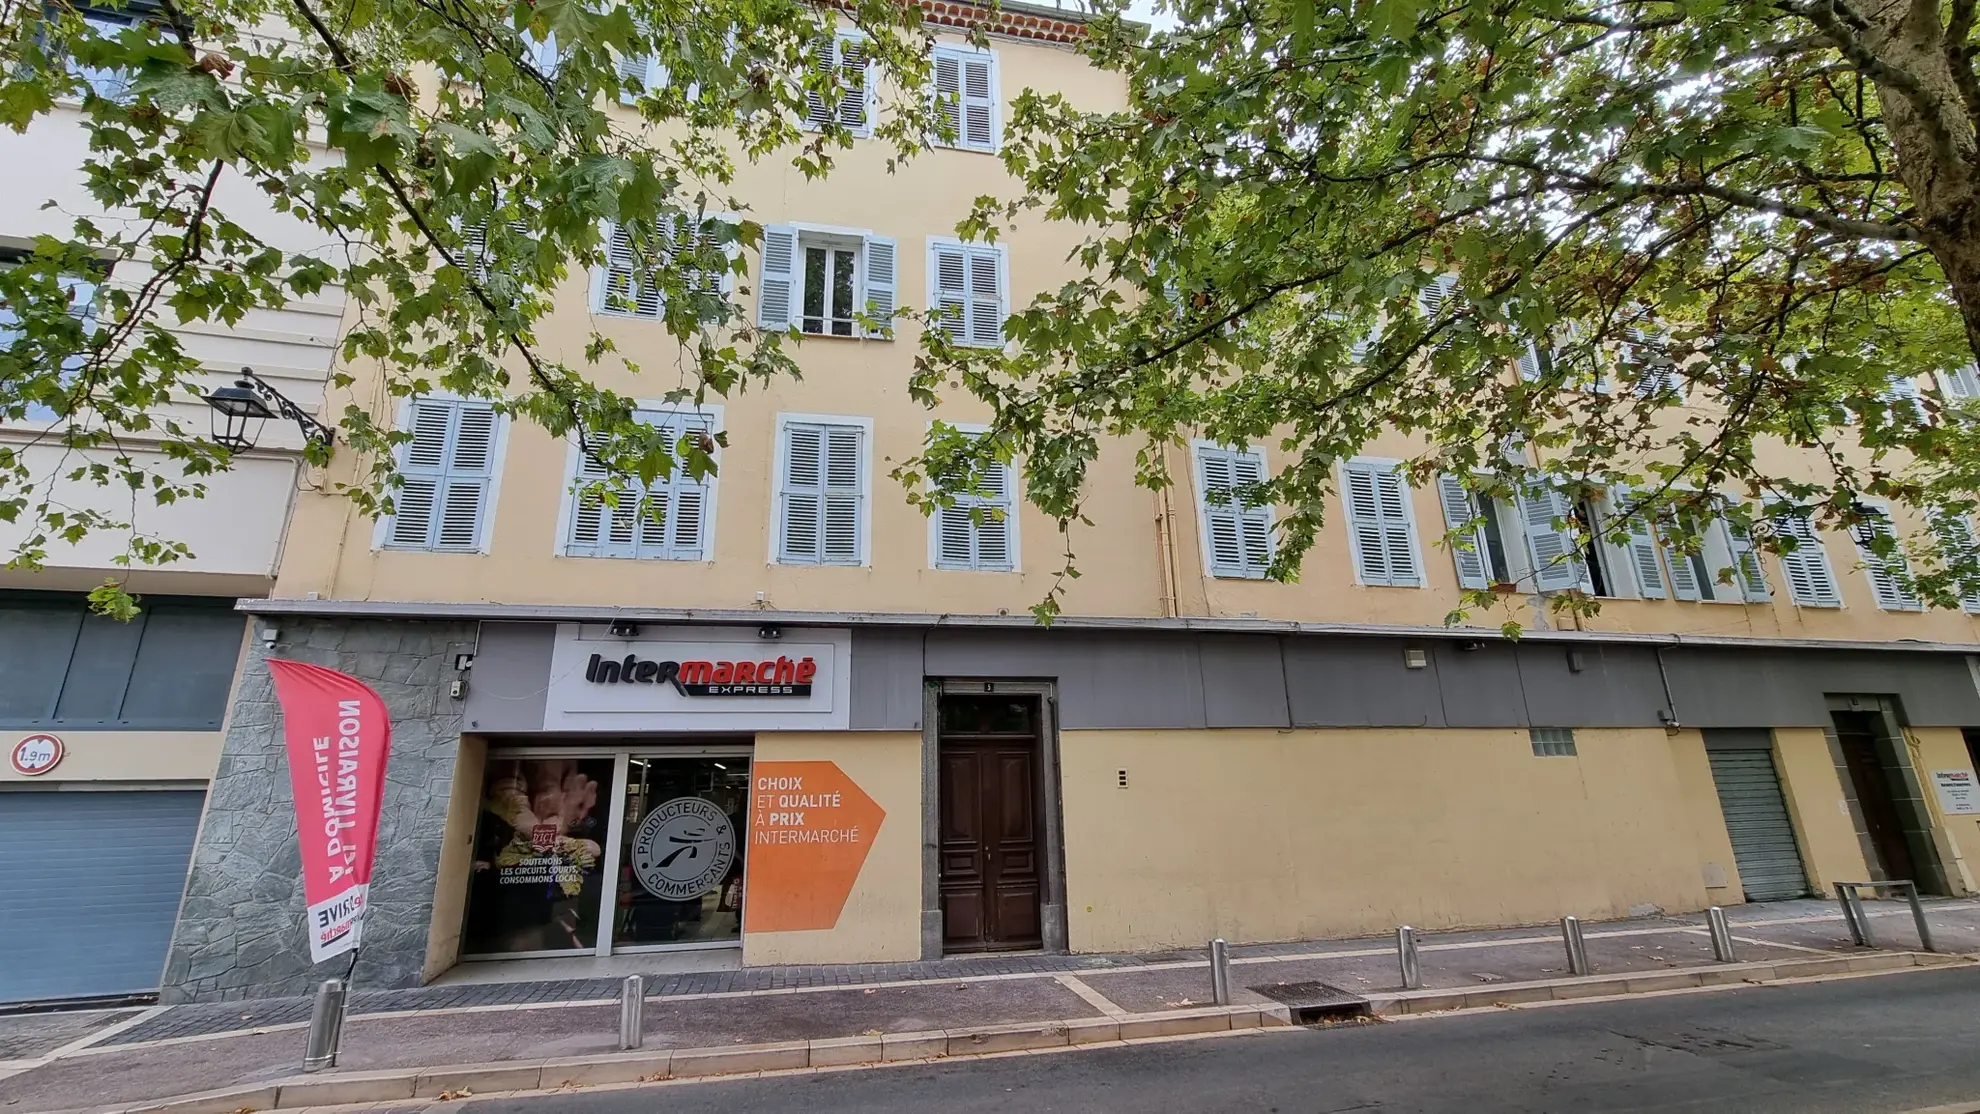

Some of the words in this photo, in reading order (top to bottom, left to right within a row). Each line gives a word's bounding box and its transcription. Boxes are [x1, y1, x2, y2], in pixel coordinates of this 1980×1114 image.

[586, 653, 817, 698] Intermarché
[709, 685, 793, 694] EXPRESS
[758, 777, 802, 790] CHOIX
[757, 794, 775, 809] ET
[779, 790, 841, 808] QUALITÉ
[754, 809, 765, 826] À
[769, 812, 805, 826] PRIX
[637, 802, 718, 855] PRODUCTEURS
[716, 824, 727, 835] &
[754, 825, 860, 844] INTERMARCHÉ
[519, 857, 563, 867] SOUTENONS
[500, 867, 513, 875] LES
[515, 866, 547, 875] CIRCUITS
[548, 865, 579, 875] COURTS,
[500, 875, 554, 884] CONSOMMONS
[555, 874, 577, 883] LOCAL
